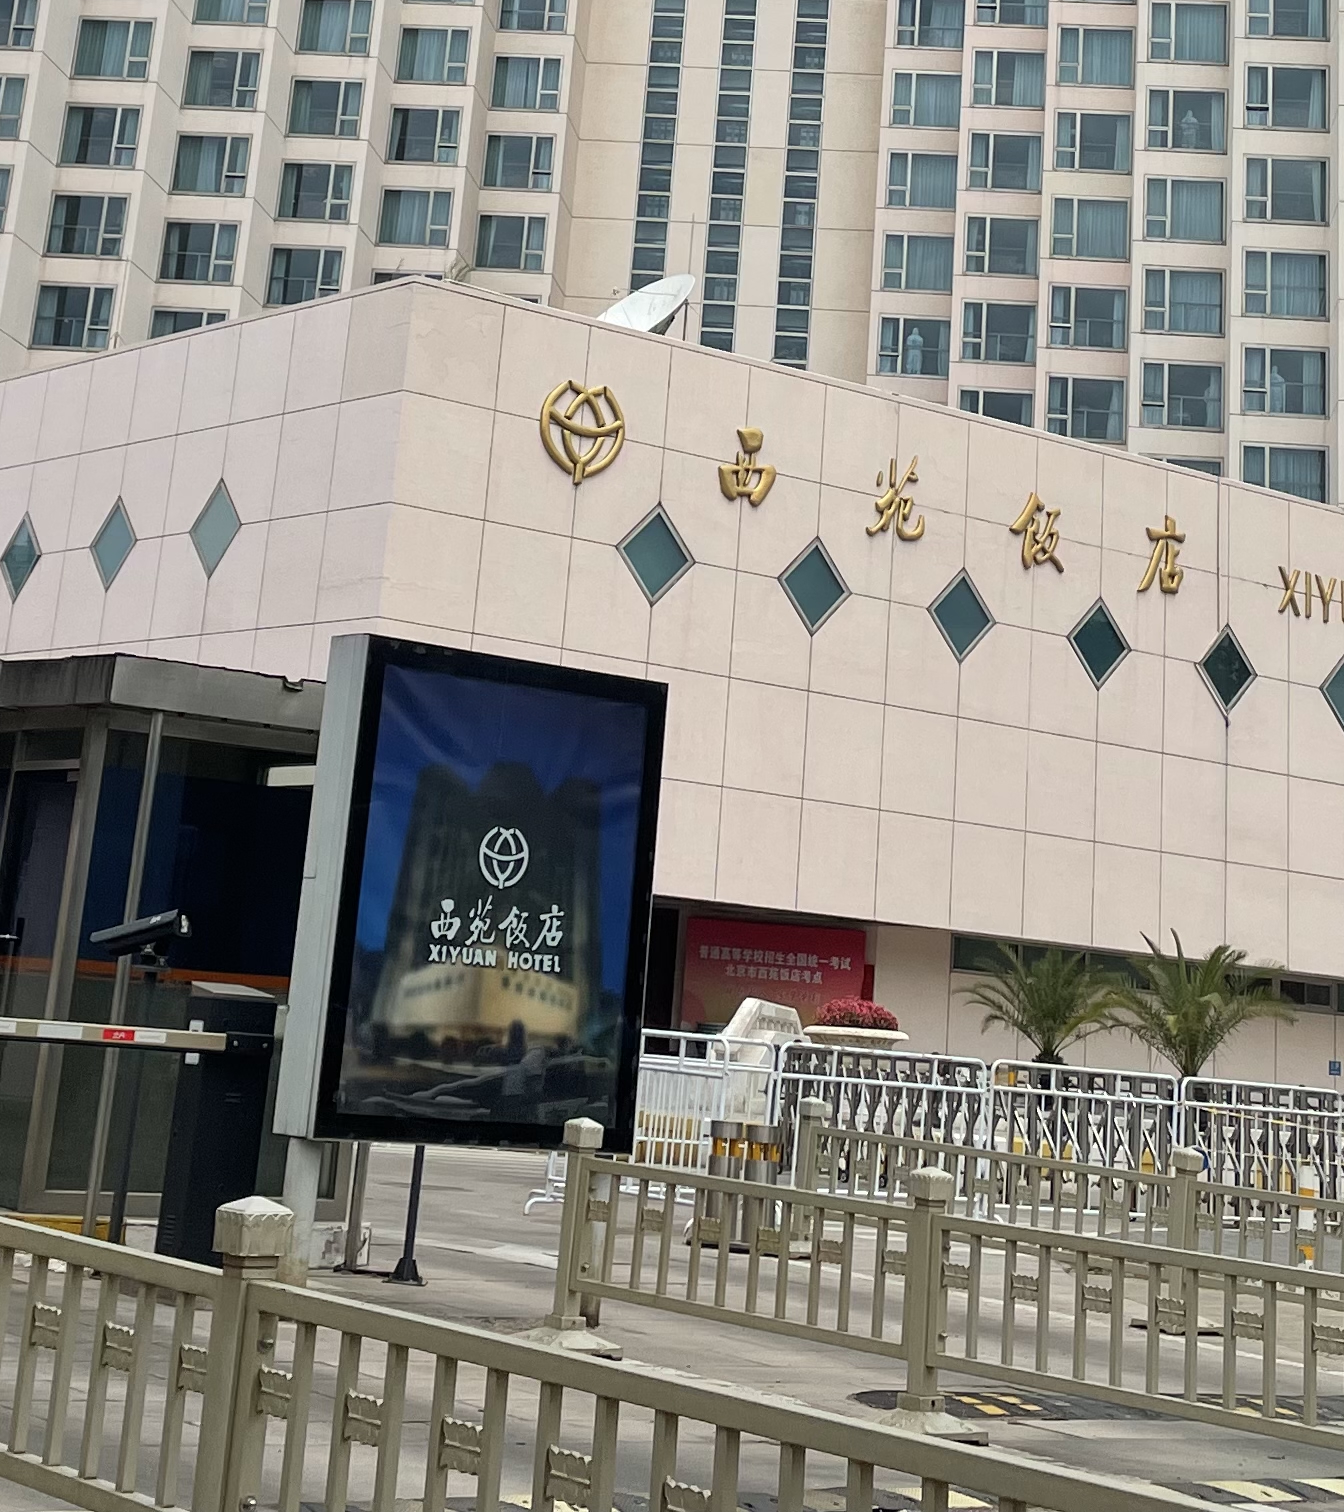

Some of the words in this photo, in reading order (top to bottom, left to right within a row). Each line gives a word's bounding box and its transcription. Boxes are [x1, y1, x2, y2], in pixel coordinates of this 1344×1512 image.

[718, 427, 1186, 595] 西苑饭店
[429, 894, 566, 952] 西苑饭店
[428, 944, 497, 968] XIYUAN
[507, 951, 561, 973] HOTEL
[699, 945, 852, 971] 普通高等学校招生全国统一考试
[725, 964, 823, 985] 北京市西苑饭店考点
